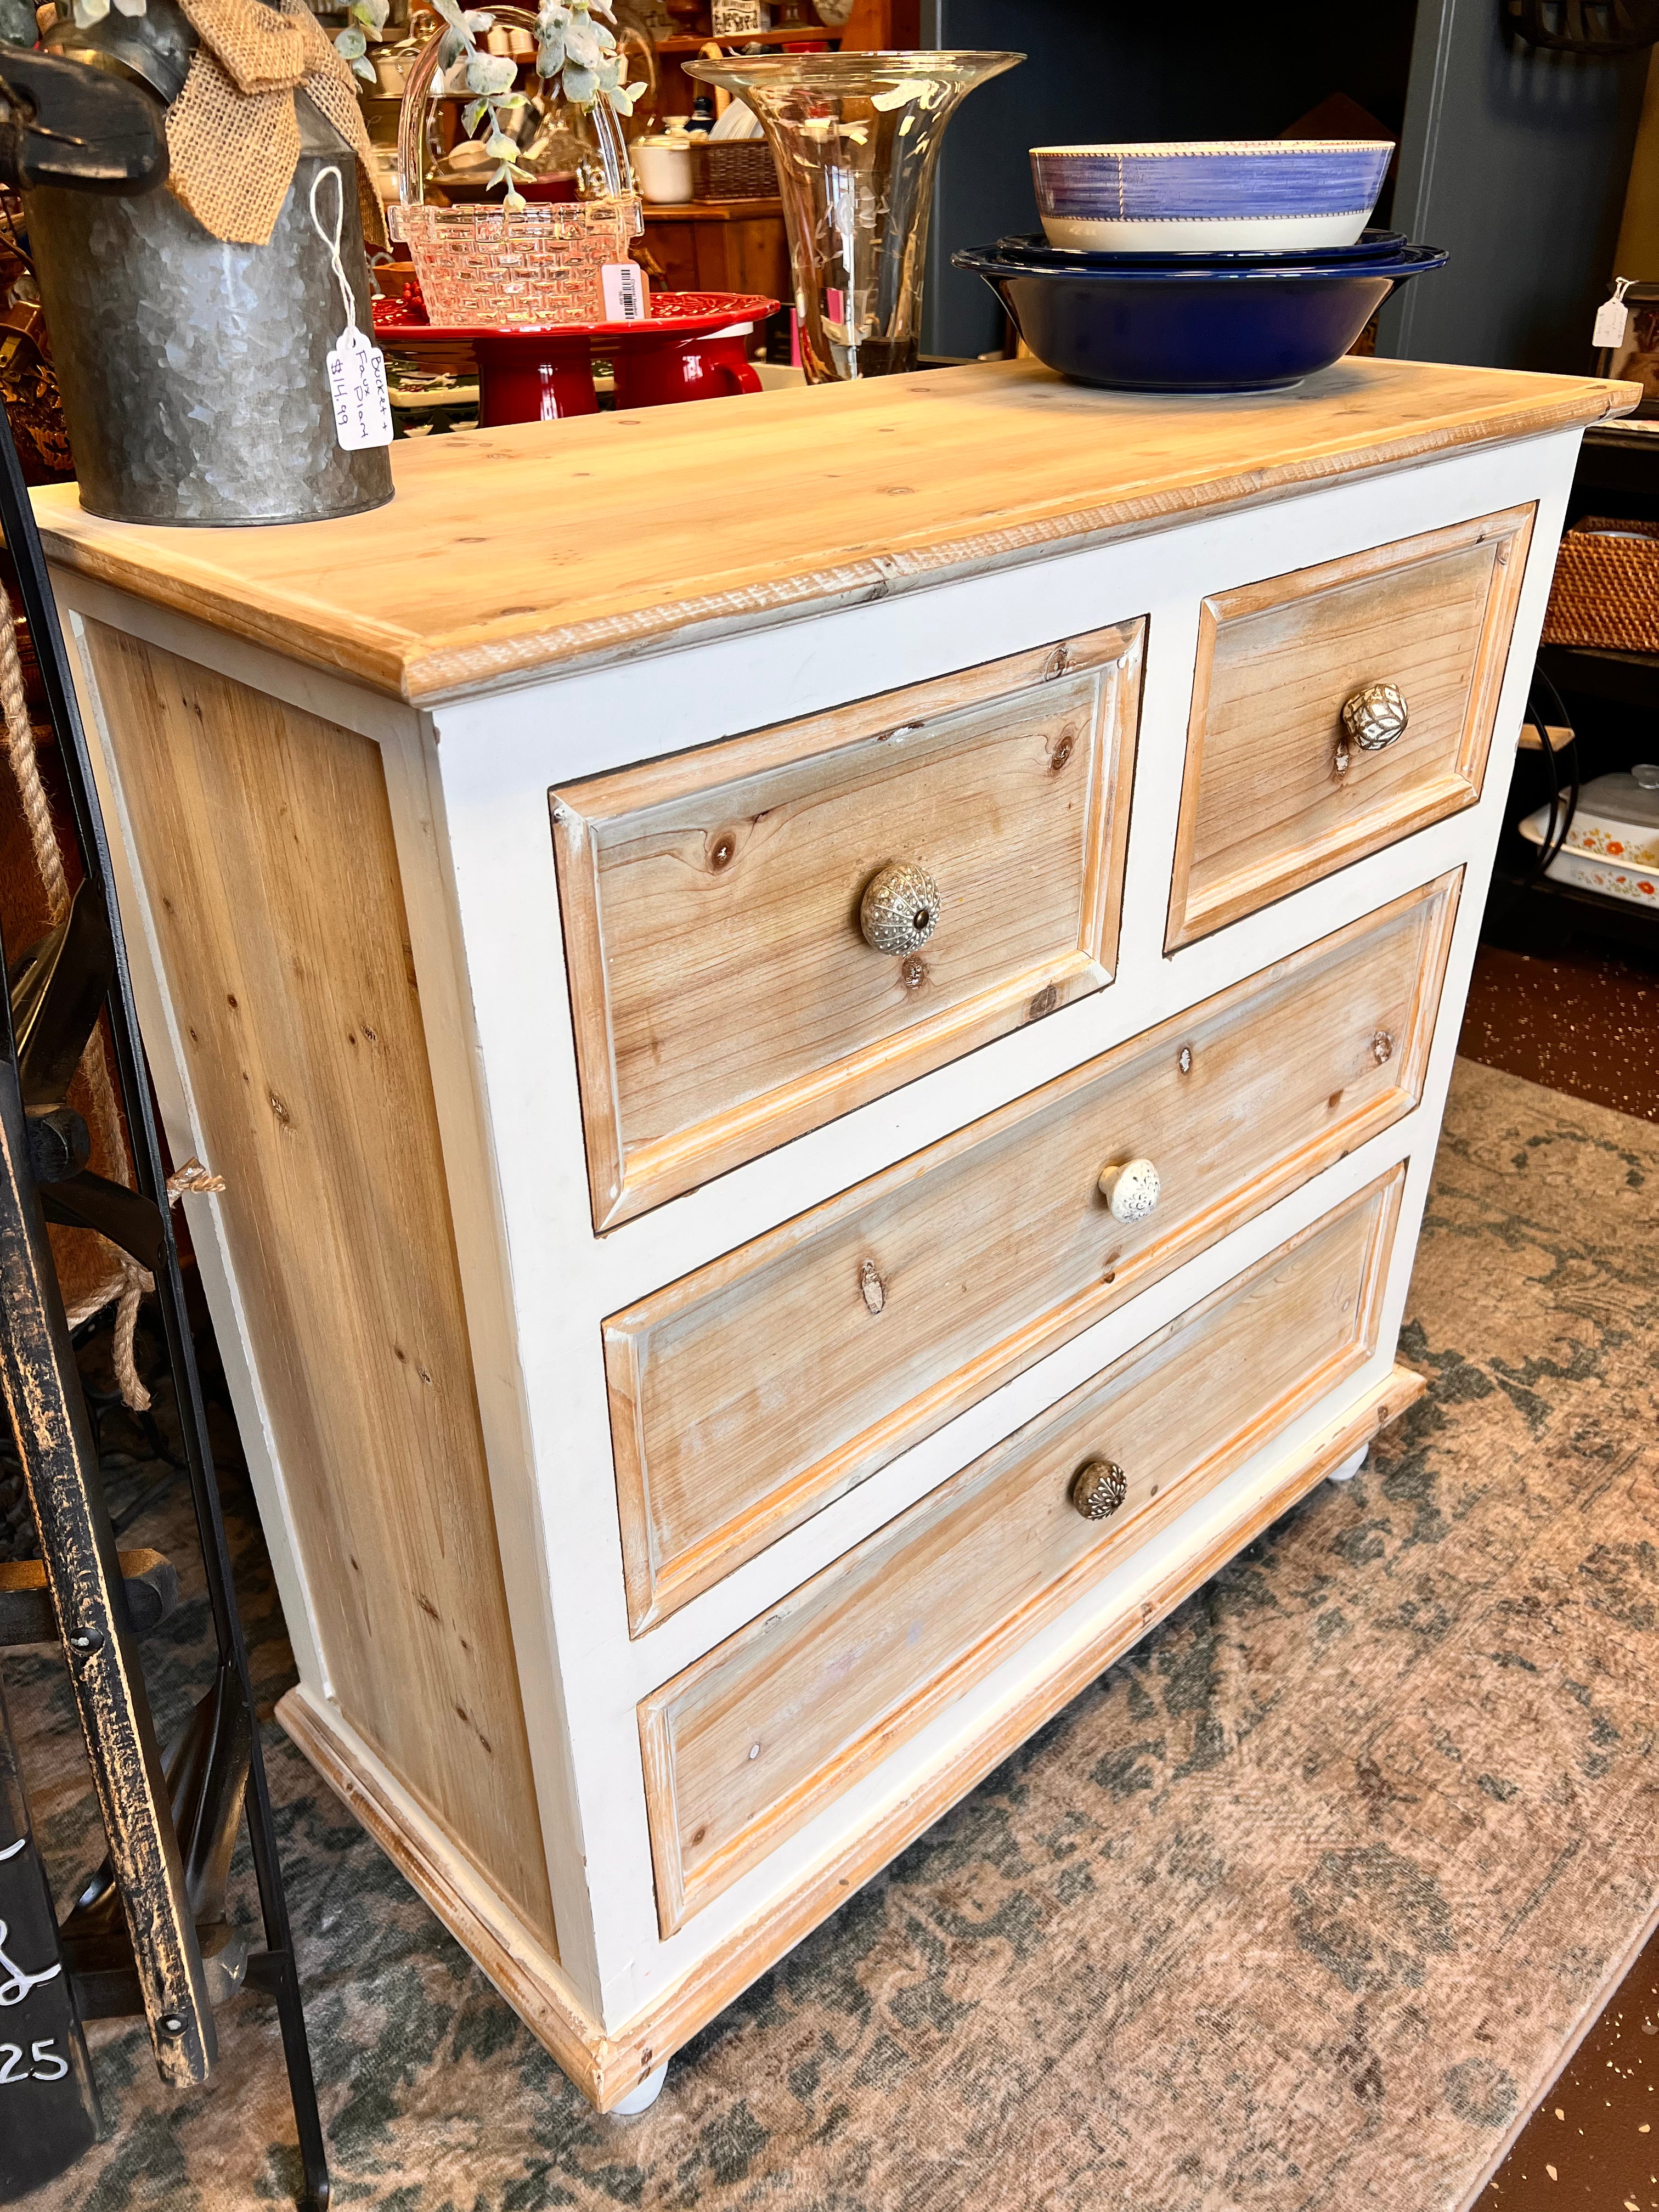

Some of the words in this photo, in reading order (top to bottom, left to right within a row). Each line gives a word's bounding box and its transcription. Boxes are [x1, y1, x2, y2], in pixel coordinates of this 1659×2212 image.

[331, 359, 348, 425] $14.99
[356, 350, 370, 396] Faux
[371, 356, 386, 415] Bucket
